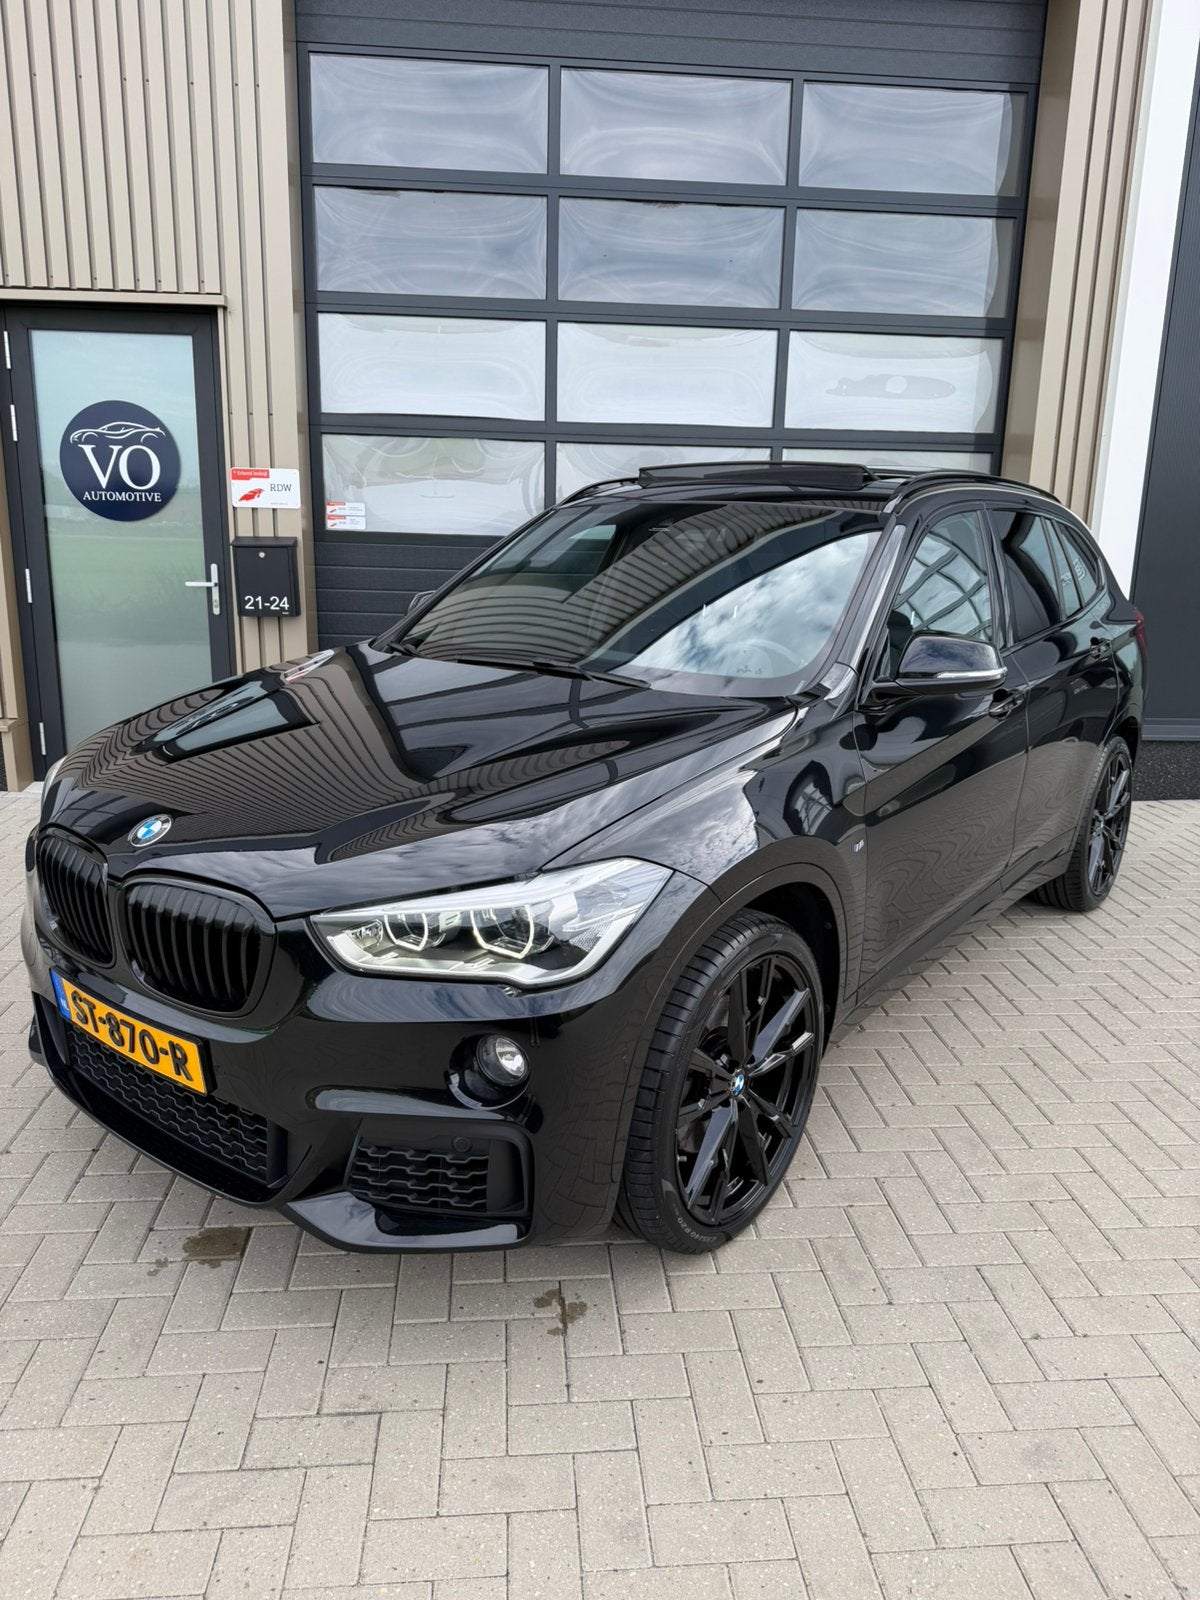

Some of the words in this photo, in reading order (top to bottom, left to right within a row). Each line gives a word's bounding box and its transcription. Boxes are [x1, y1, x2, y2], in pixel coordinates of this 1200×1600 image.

[77, 444, 161, 490] VO
[270, 483, 292, 492] RDW
[82, 490, 162, 503] AUTOMOTIVE
[244, 595, 290, 610] 21-24
[70, 990, 193, 1081] ST-870-R
